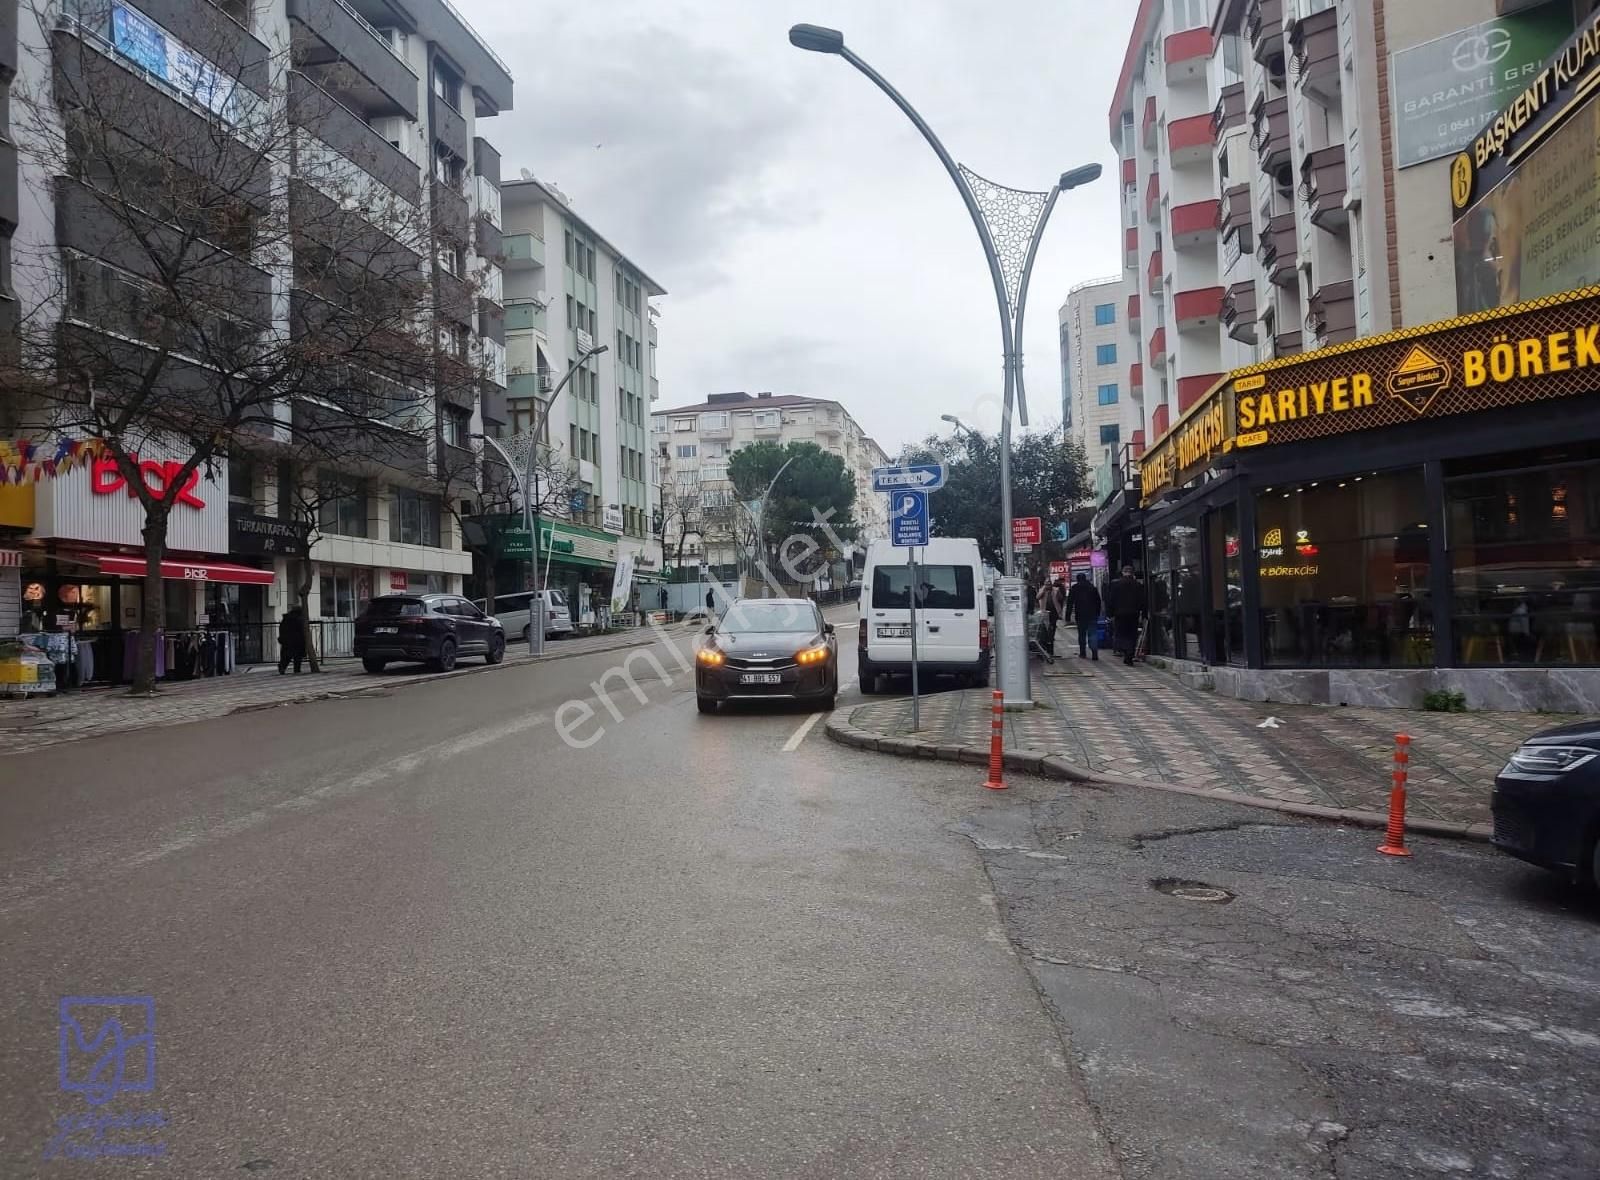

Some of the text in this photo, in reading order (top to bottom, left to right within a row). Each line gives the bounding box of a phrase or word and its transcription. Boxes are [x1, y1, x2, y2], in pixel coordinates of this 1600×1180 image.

[1404, 72, 1494, 113] GARANTİ
[1475, 68, 1549, 169] BAŞKENT
[1240, 372, 1374, 428] SARIYER
[1242, 433, 1263, 444] CAFE
[903, 496, 915, 515] P
